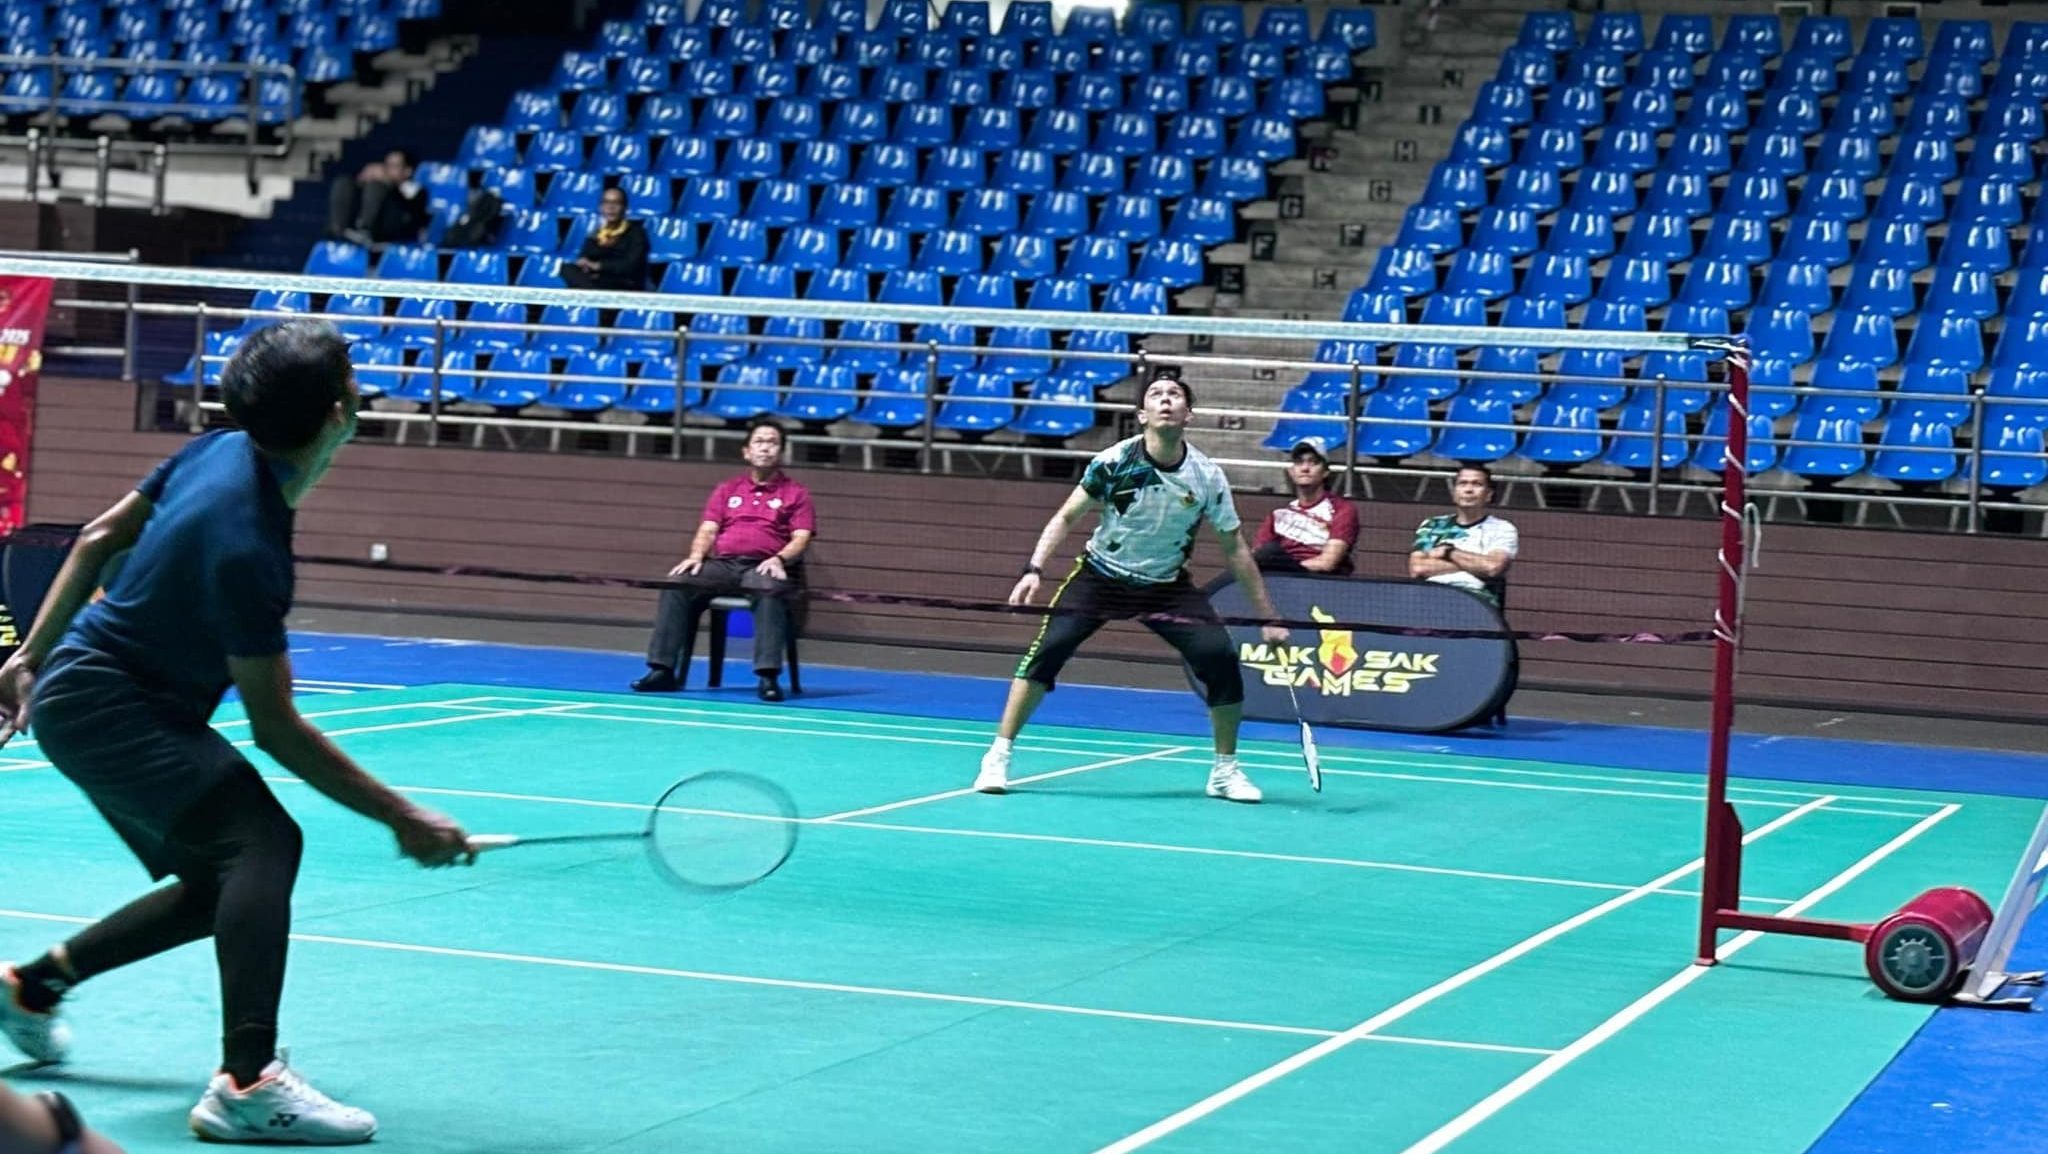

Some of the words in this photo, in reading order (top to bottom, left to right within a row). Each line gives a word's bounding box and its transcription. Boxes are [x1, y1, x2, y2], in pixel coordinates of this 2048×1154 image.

[1396, 141, 1415, 161] H
[1371, 181, 1390, 201] G
[1281, 197, 1302, 217] G
[1254, 233, 1274, 258] F
[1343, 225, 1362, 246] F
[1221, 267, 1241, 290] E
[1240, 642, 1315, 666] MAK
[1364, 650, 1441, 673] SAK
[1246, 663, 1430, 697] GAMES
